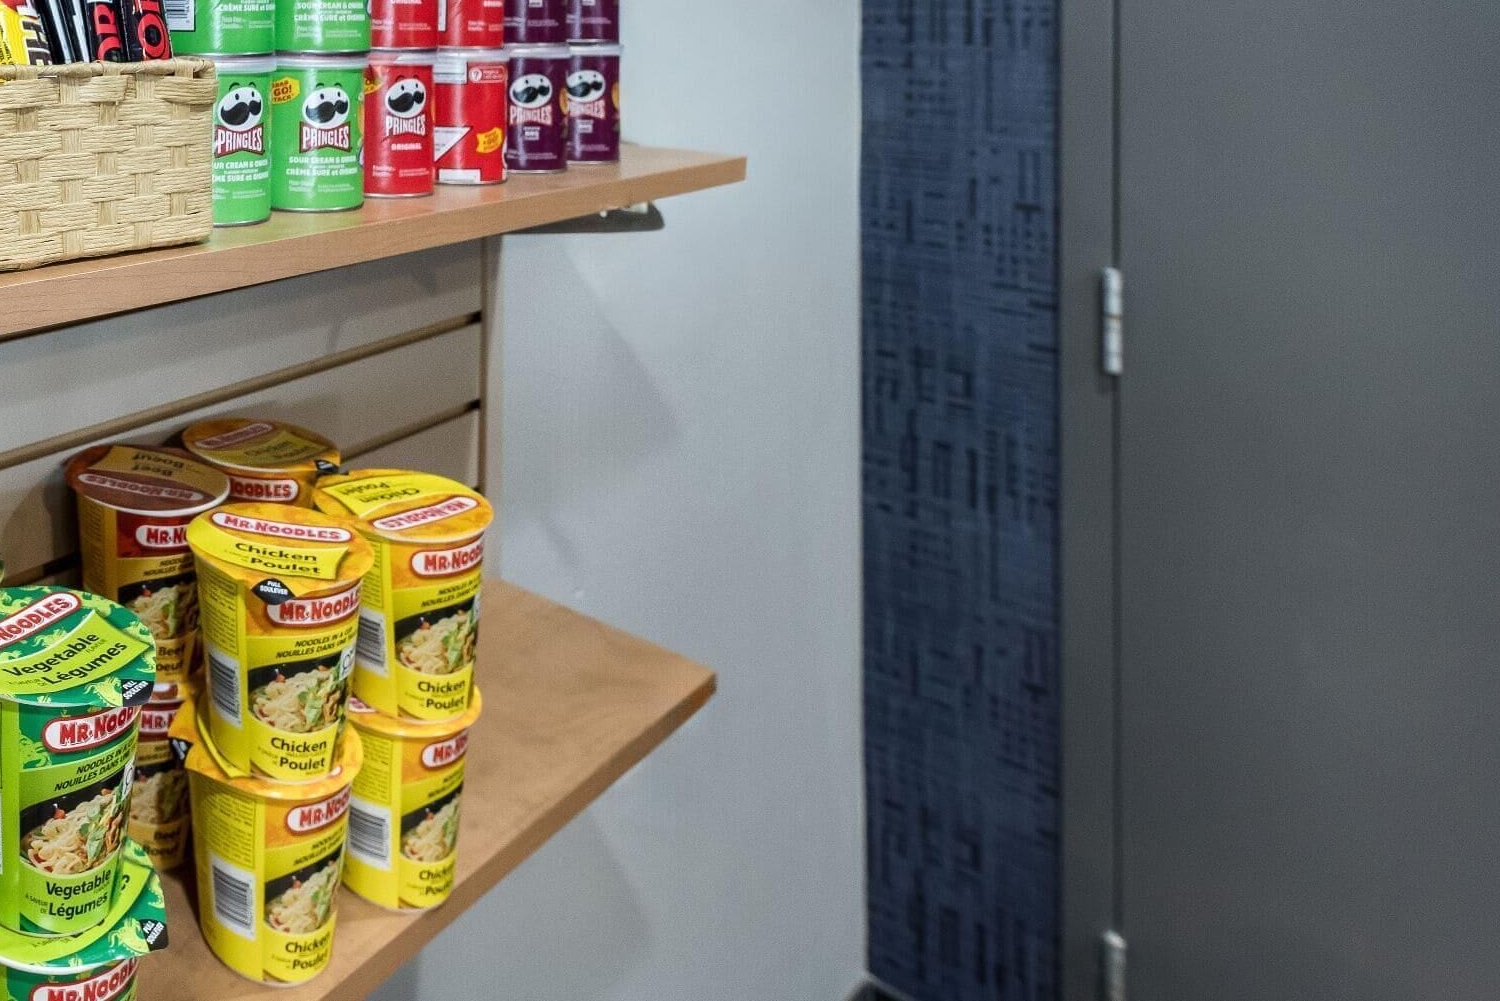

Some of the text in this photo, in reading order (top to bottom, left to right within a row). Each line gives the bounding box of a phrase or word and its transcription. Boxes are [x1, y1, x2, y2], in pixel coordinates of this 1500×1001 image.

[386, 116, 426, 137] PRINGLES
[510, 106, 552, 126] PRINGLES
[218, 126, 262, 155] PRINGLES
[302, 126, 349, 153] PRINGLES
[391, 143, 422, 151] ORIGINAL
[235, 542, 318, 562] Chicken
[250, 557, 320, 574] Poulet
[279, 590, 359, 621] MR.NOODL
[2, 632, 100, 678] Vegetable
[42, 642, 128, 685] Légumes
[418, 680, 466, 694] Chicken
[426, 696, 465, 710] Poulet
[60, 706, 134, 746] MR.NOOD
[271, 736, 327, 753] Chicken
[76, 756, 114, 775] NOODLES
[279, 756, 326, 772] Poulet
[54, 769, 98, 792] NOUILLES
[46, 868, 111, 901] Vegetable
[50, 892, 108, 920] Légumes
[285, 932, 330, 954] Chicken
